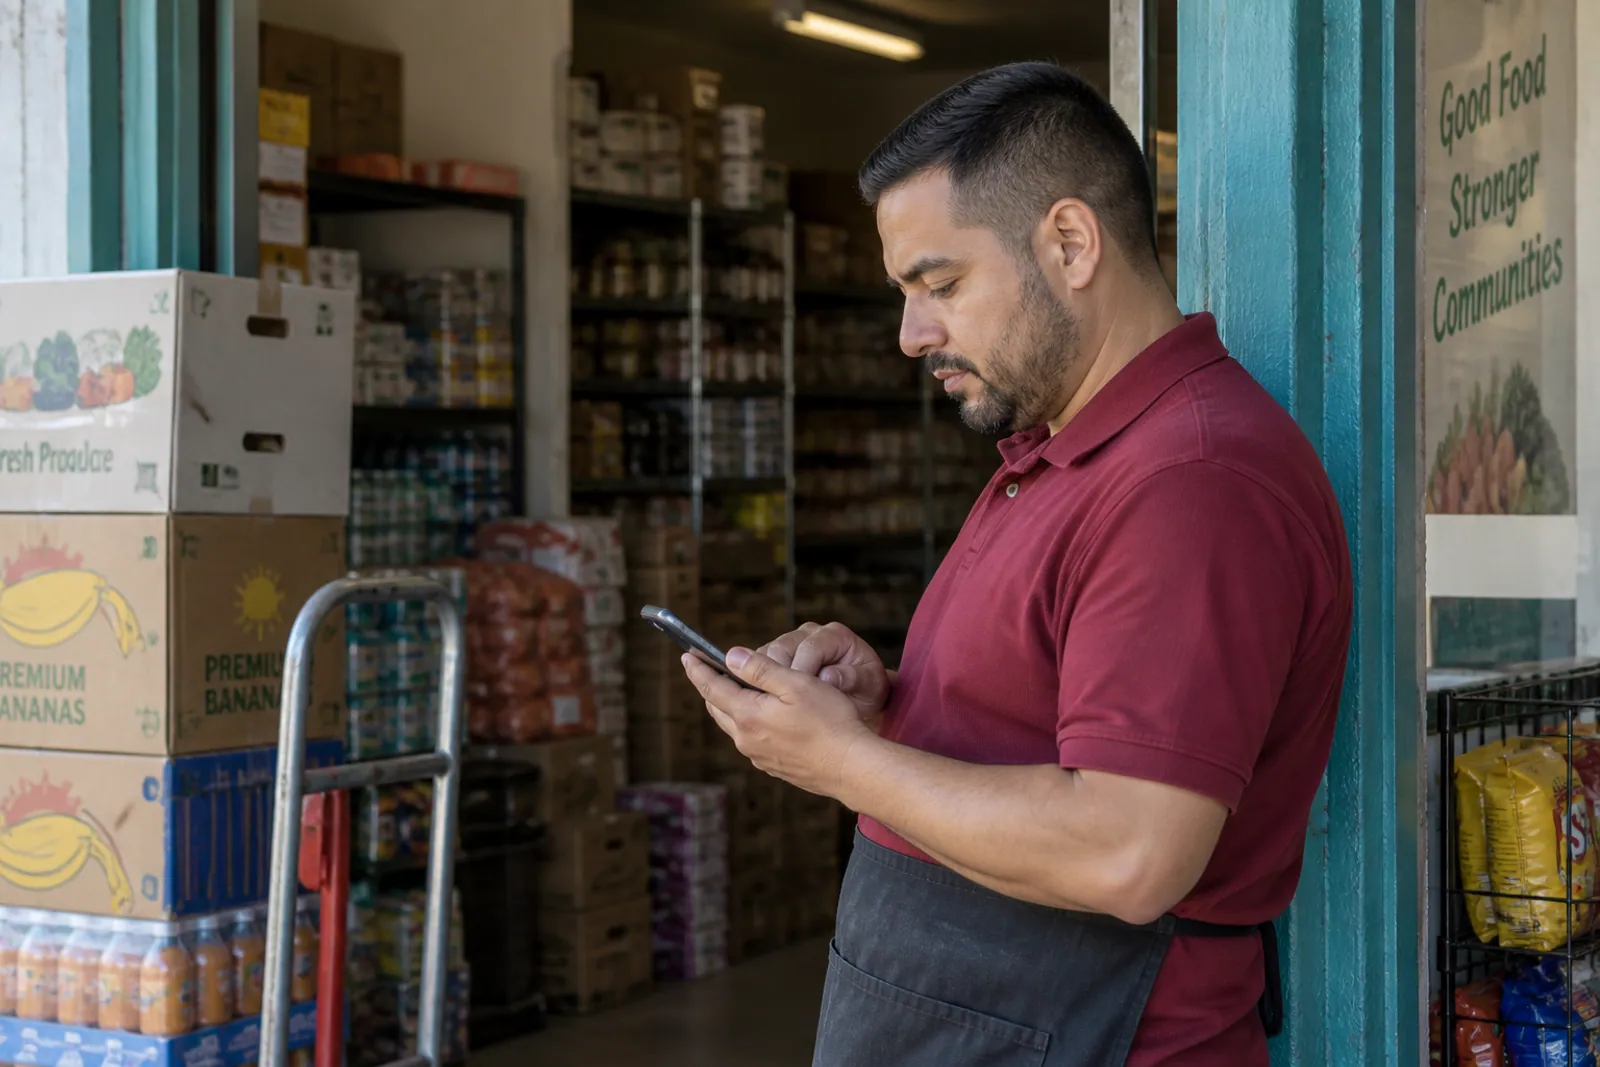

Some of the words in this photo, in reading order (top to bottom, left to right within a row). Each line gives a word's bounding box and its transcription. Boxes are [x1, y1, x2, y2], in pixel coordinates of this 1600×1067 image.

[1440, 60, 1491, 156] Good
[1499, 33, 1546, 118] Food
[1449, 152, 1540, 238] Stronger
[1433, 233, 1563, 343] Communities
[0, 440, 34, 473] resh
[0, 661, 86, 691] REMIUM
[205, 652, 313, 682] PREMIU
[0, 695, 86, 726] ANANAS
[205, 684, 312, 716] BANAN
